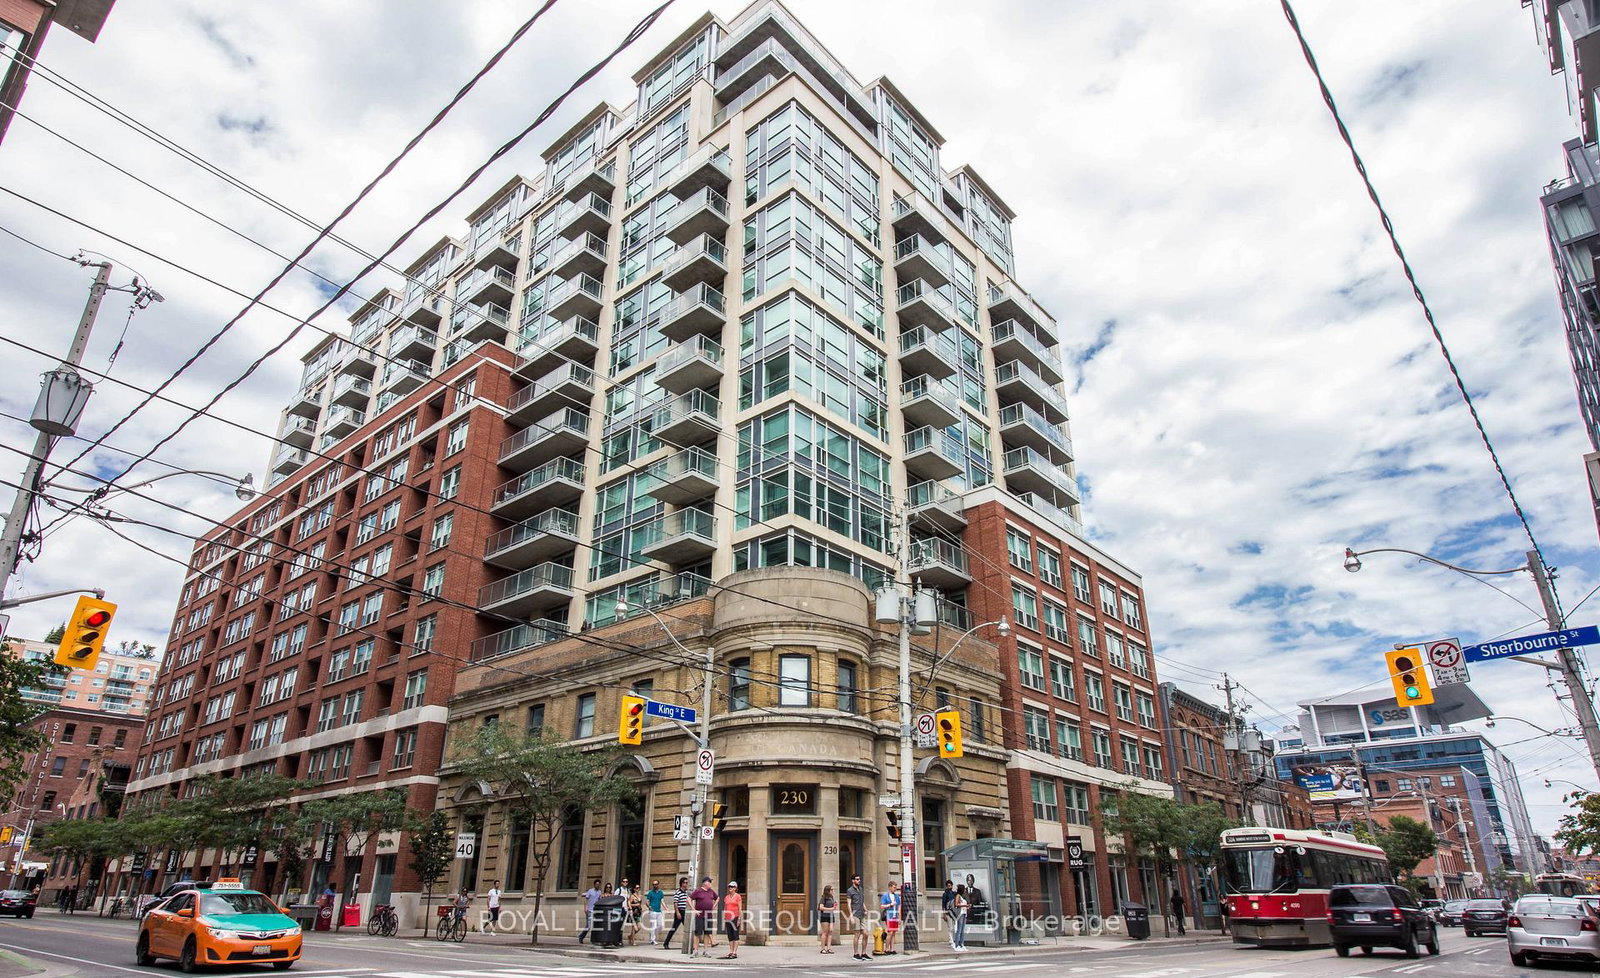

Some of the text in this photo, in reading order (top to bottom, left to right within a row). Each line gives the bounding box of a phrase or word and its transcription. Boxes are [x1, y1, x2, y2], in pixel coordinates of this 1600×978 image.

[1481, 634, 1568, 657] Sherbourne
[658, 704, 674, 717] King
[680, 708, 685, 718] E
[41, 722, 60, 768] STUDIO
[776, 743, 838, 756] CANADA
[31, 772, 45, 802] CITY
[780, 790, 808, 805] 230
[457, 843, 473, 855] 40
[824, 846, 838, 855] 230
